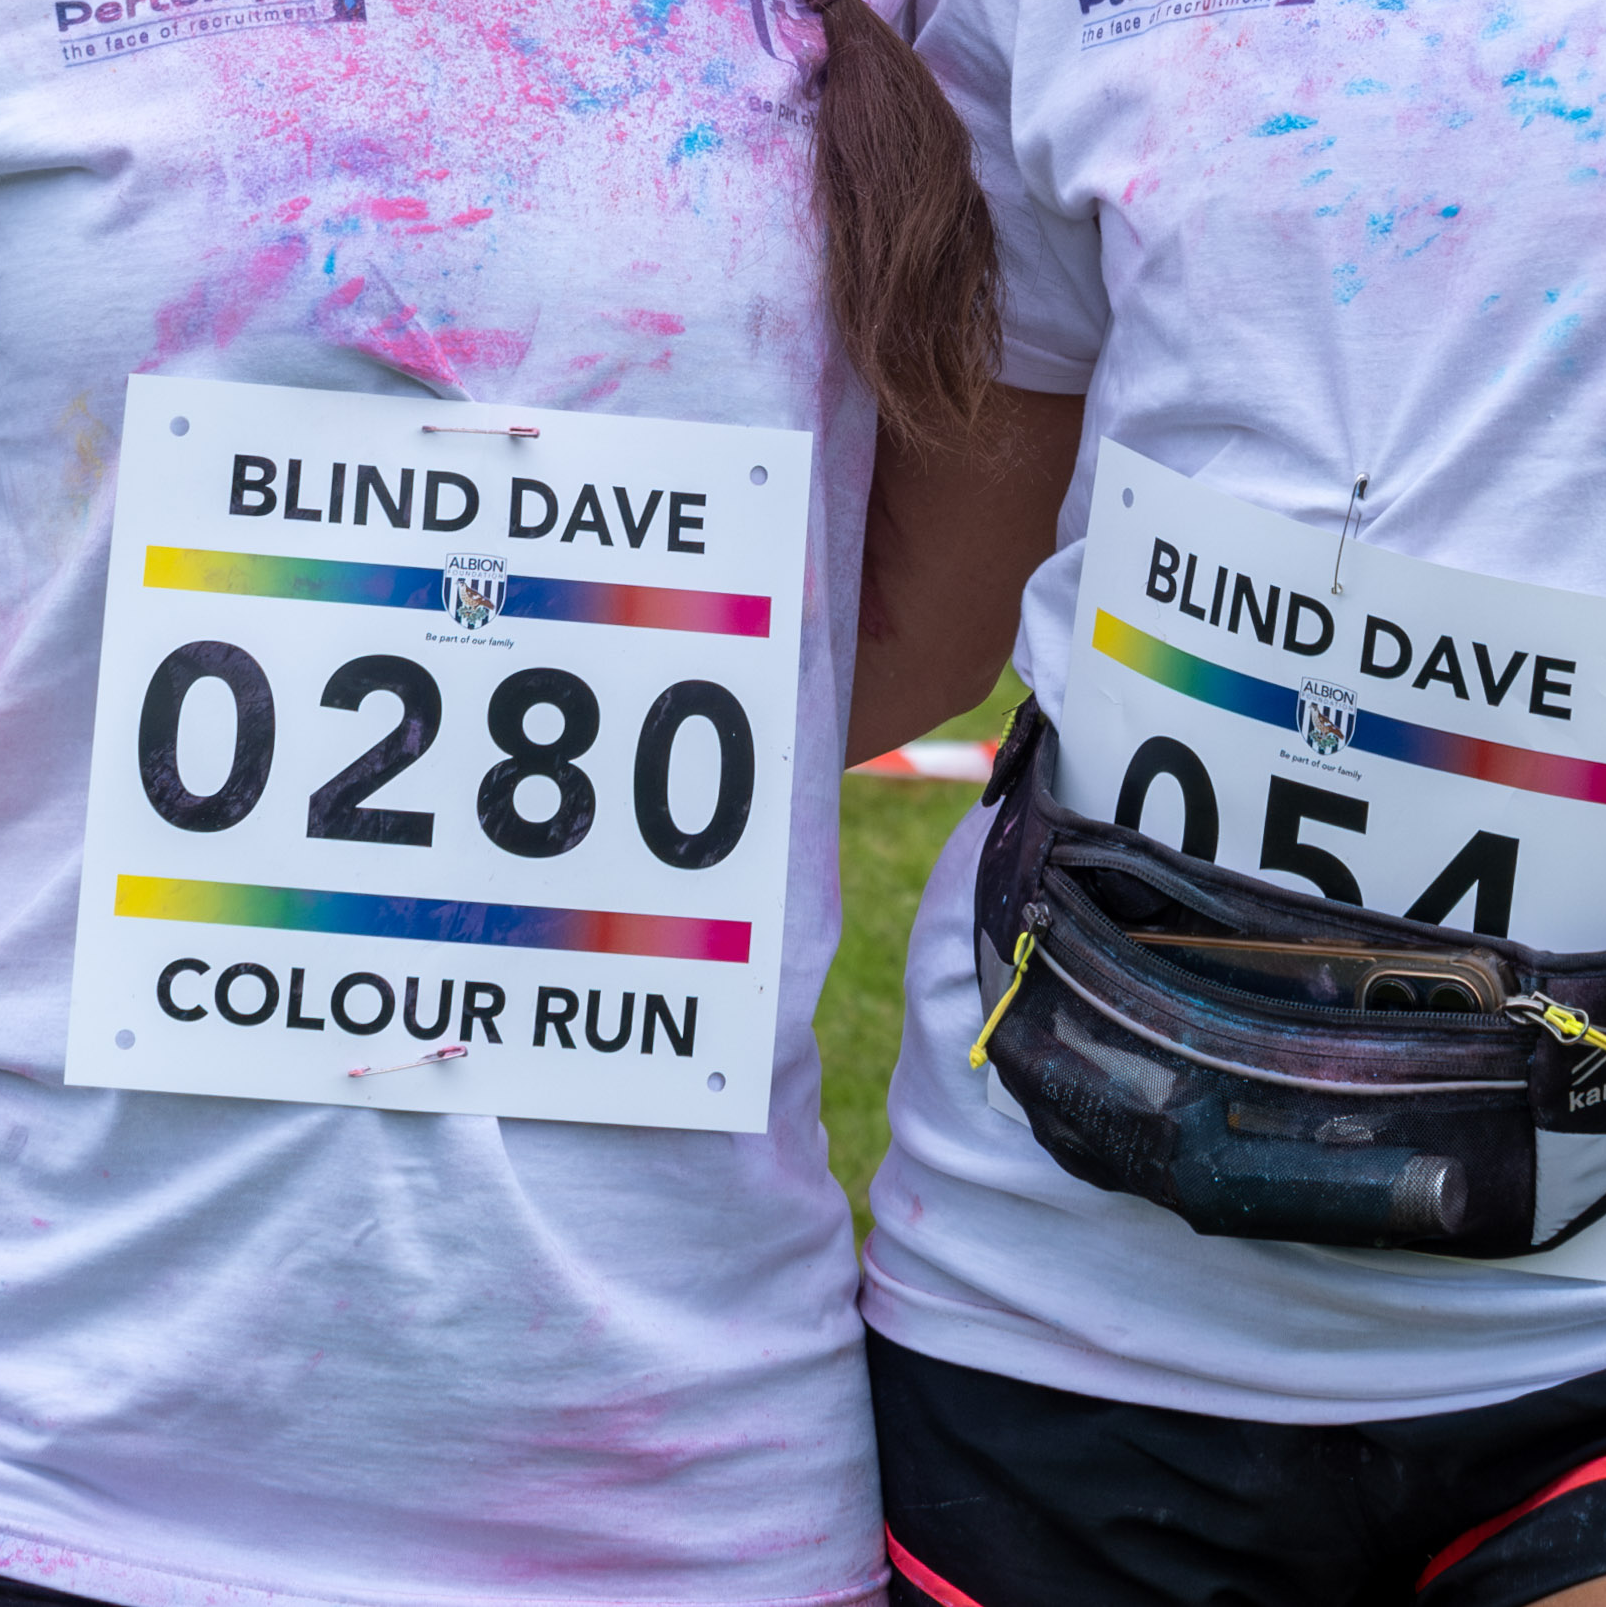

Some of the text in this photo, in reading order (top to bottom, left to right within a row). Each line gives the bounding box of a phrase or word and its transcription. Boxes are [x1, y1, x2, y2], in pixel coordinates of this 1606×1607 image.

[63, 6, 316, 61] the face of recruitment
[1082, 26, 1104, 44] the
[1110, 16, 1141, 36] face
[1149, 9, 1162, 24] of
[229, 453, 707, 555] BLIND DAVE
[449, 557, 504, 572] ALBION
[425, 632, 437, 641] Be
[439, 635, 457, 643] part
[460, 635, 470, 643] of
[488, 637, 514, 649] family
[1145, 537, 1577, 721] BLIND DAVE
[1304, 681, 1354, 706] ALBION
[138, 640, 755, 869] 0280
[1280, 749, 1362, 782] Be part of our family
[156, 957, 699, 1058] COLOUR RUN
